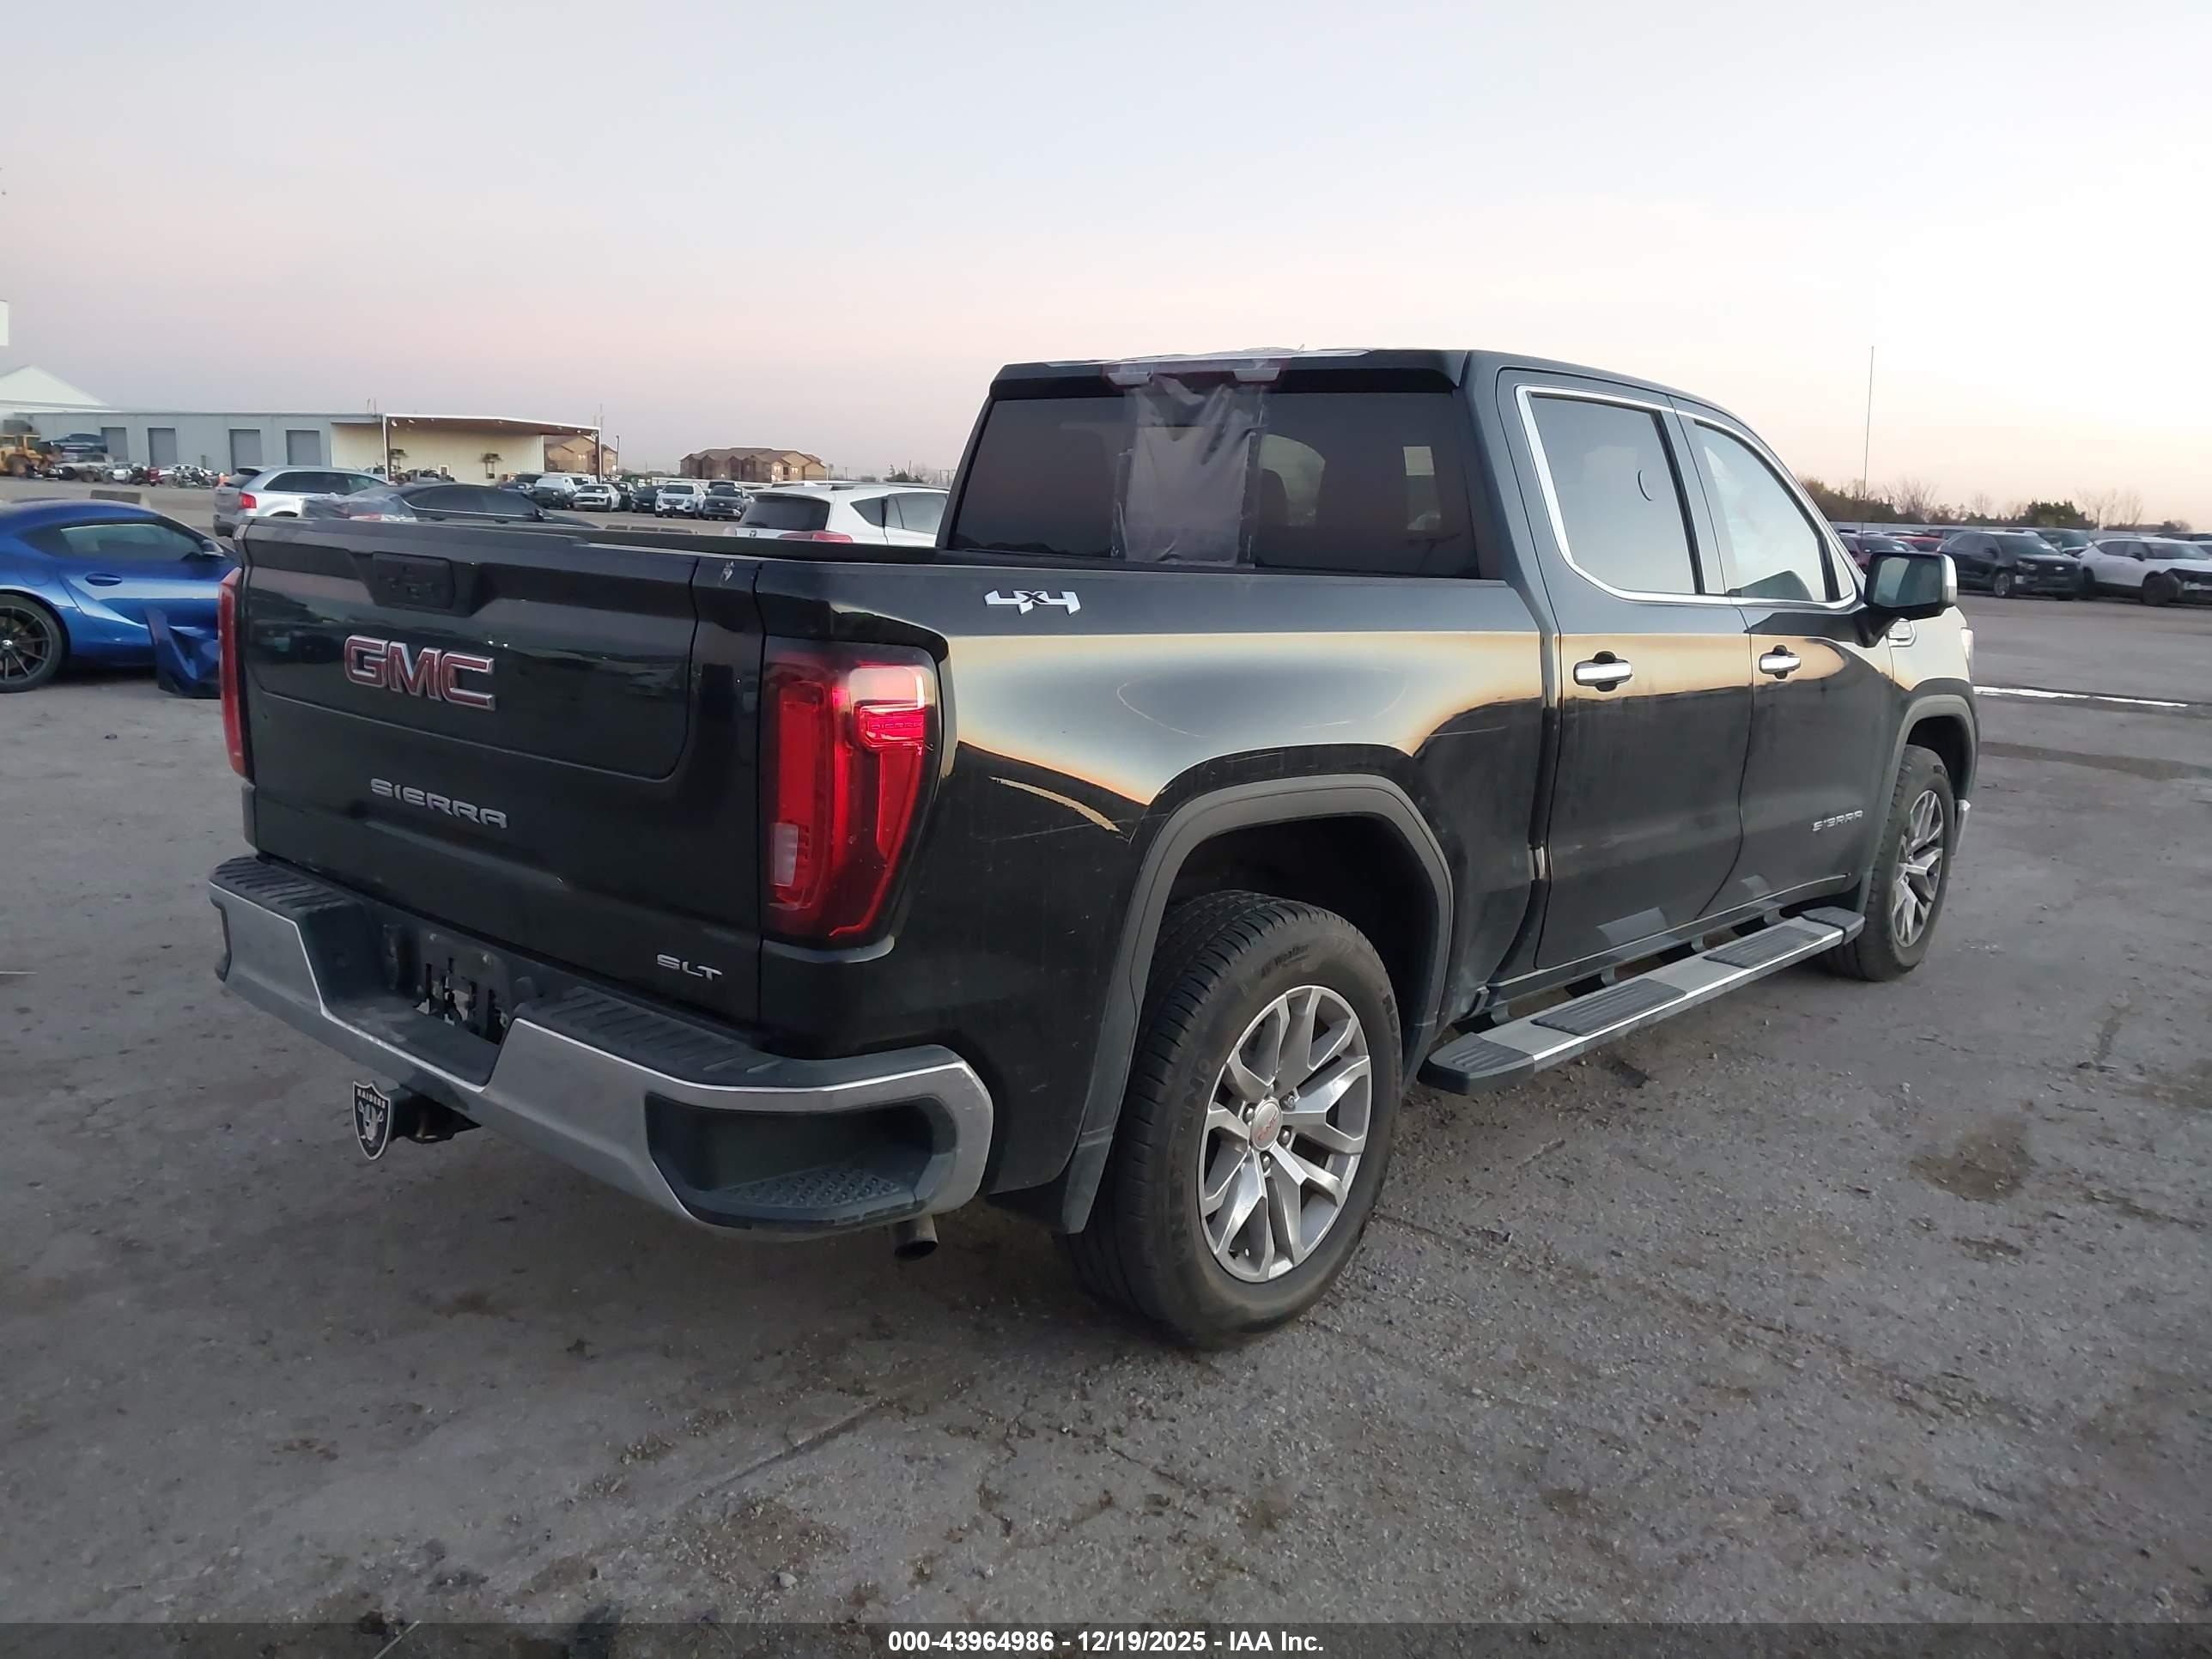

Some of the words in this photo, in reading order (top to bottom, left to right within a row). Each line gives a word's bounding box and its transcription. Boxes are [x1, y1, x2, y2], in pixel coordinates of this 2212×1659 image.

[343, 635, 496, 711] GMC
[369, 777, 507, 829] SIERRA
[656, 953, 723, 981] SLT
[357, 1088, 386, 1109] RAIDERS
